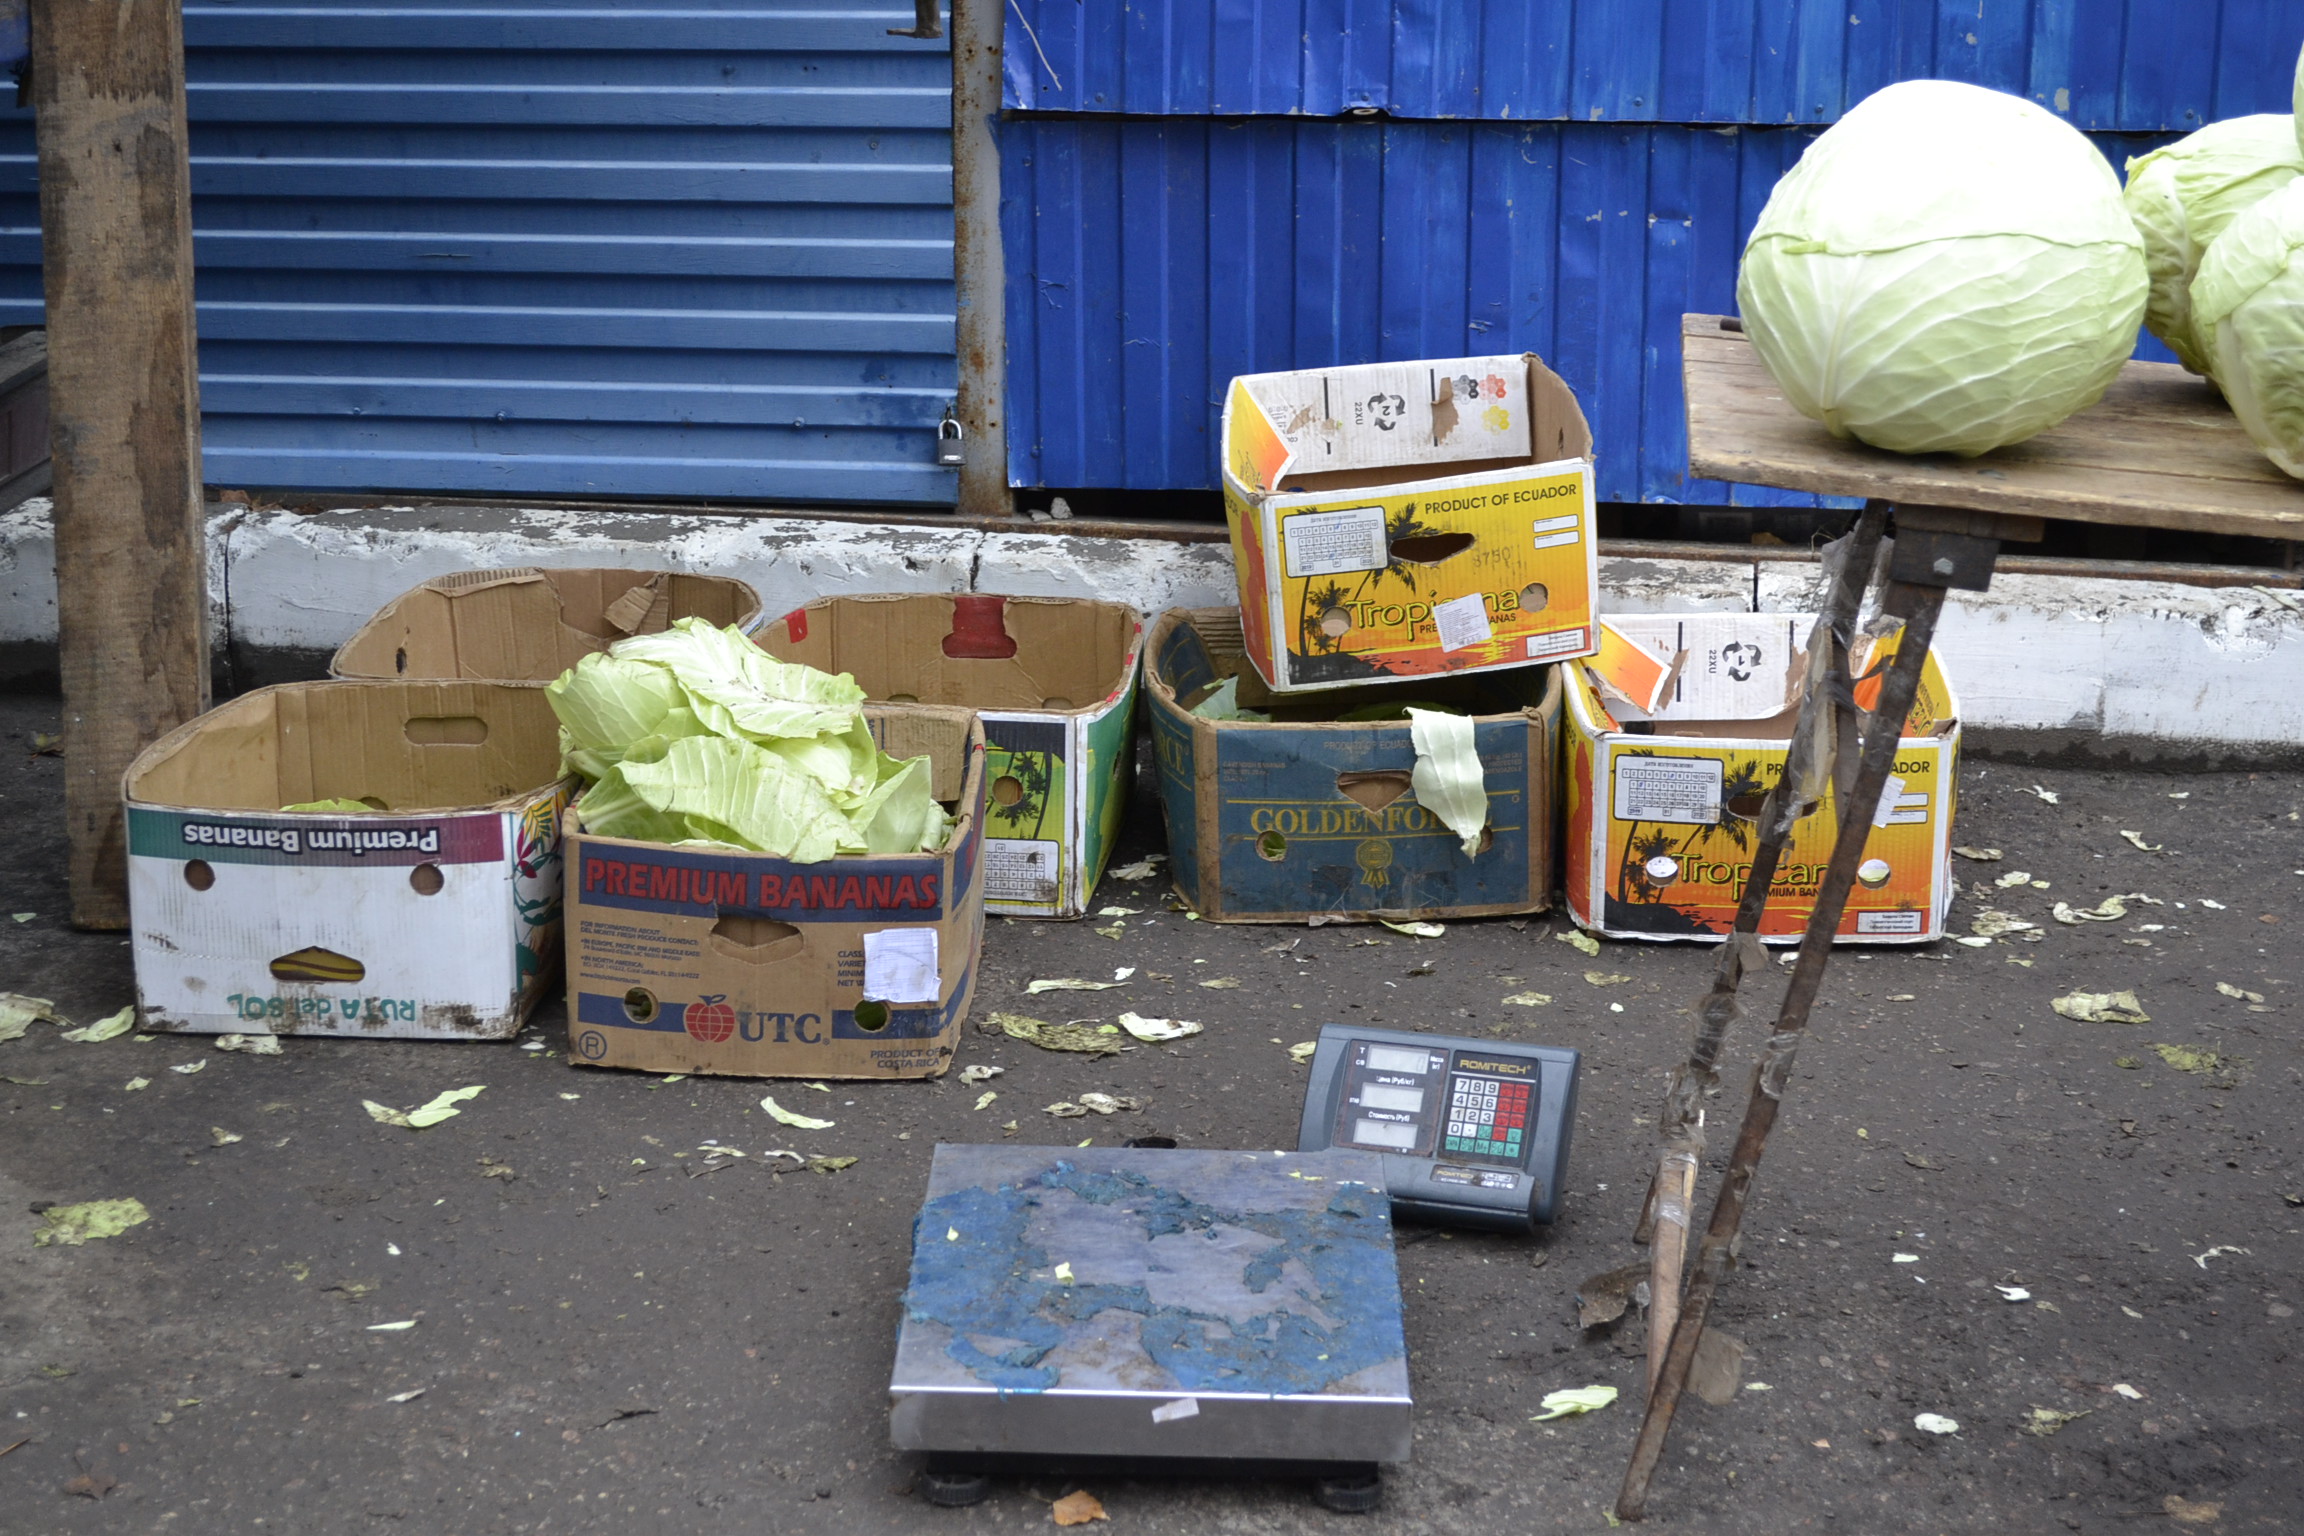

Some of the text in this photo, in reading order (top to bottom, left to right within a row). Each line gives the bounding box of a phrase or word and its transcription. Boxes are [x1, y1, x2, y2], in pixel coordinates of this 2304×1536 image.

[1425, 484, 1576, 514] PRODUCT OF ECUADOR
[1345, 589, 1520, 641] Tropina
[1489, 613, 1516, 624] ANAS
[1891, 762, 1930, 774] ADOR
[183, 823, 439, 854] Premium Bananas
[1671, 852, 1830, 901] Tropcan
[585, 857, 938, 910] PREMIUM BANANAS
[1768, 888, 1796, 897] MIUM
[227, 994, 286, 1020] SOL
[341, 997, 416, 1022] RUTA
[739, 1012, 821, 1044] UTC
[870, 1048, 940, 1060] PRODUCT OF
[877, 1057, 940, 1069] COSTA RICA
[1459, 1081, 1496, 1093] 7 8 9
[1456, 1096, 1493, 1108] 4 5 6
[1468, 1111, 1476, 1120] 2
[1483, 1113, 1491, 1122] 3
[1451, 1124, 1459, 1133] 0
